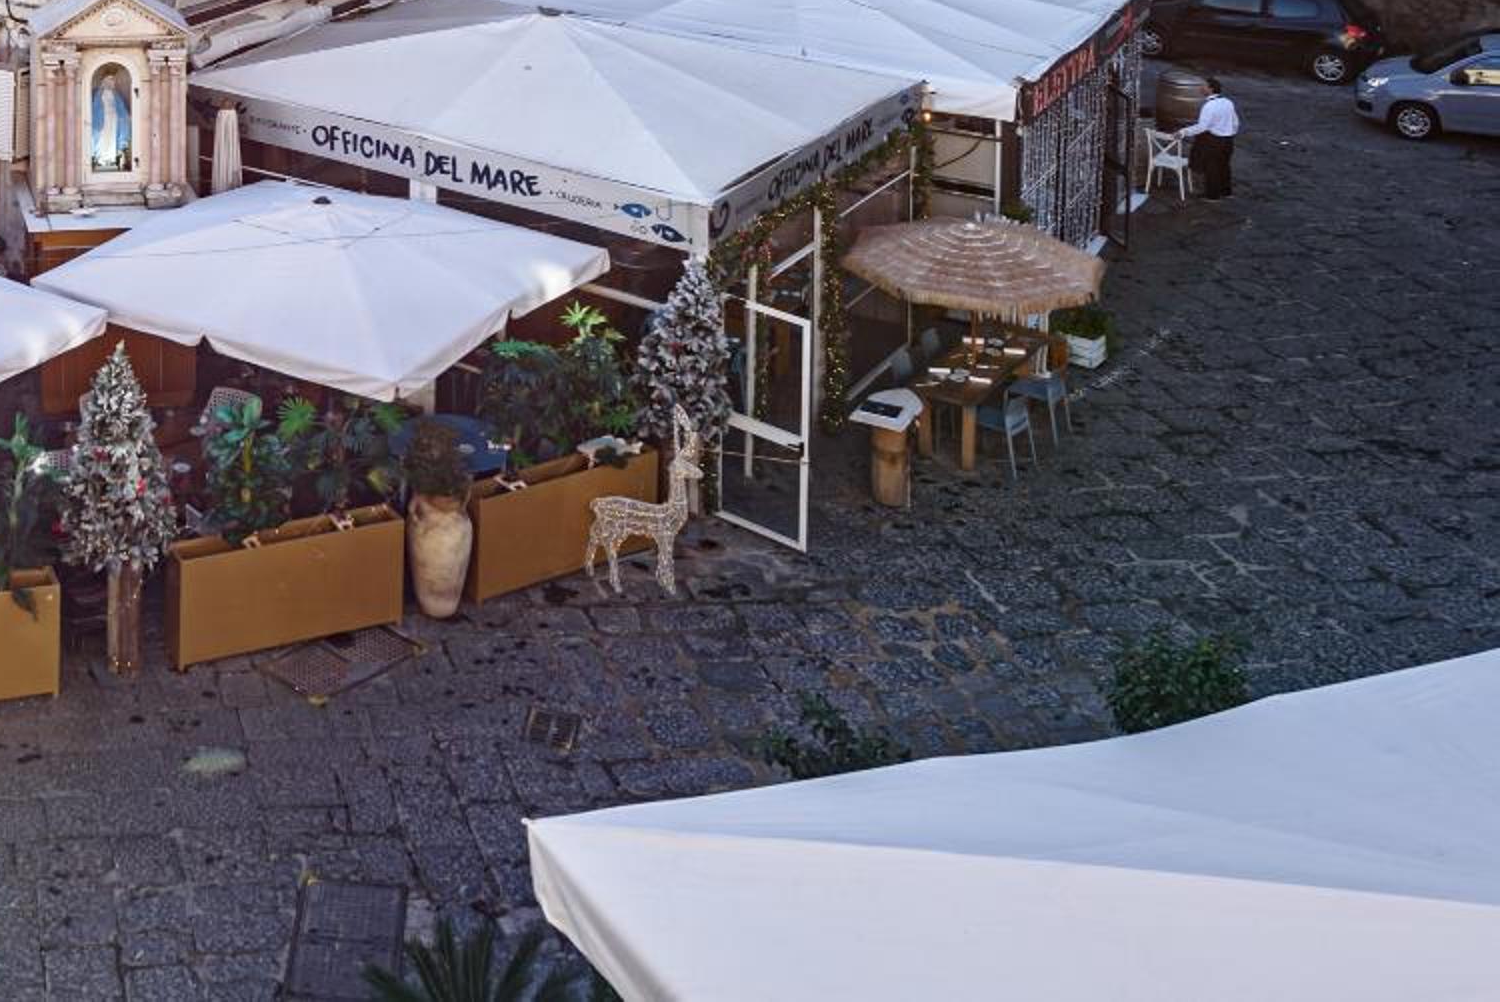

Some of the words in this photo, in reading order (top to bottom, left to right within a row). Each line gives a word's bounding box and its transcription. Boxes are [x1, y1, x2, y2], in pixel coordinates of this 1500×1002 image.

[311, 125, 416, 168] OFFICINA
[424, 150, 463, 183] DEL
[470, 161, 542, 197] MARE
